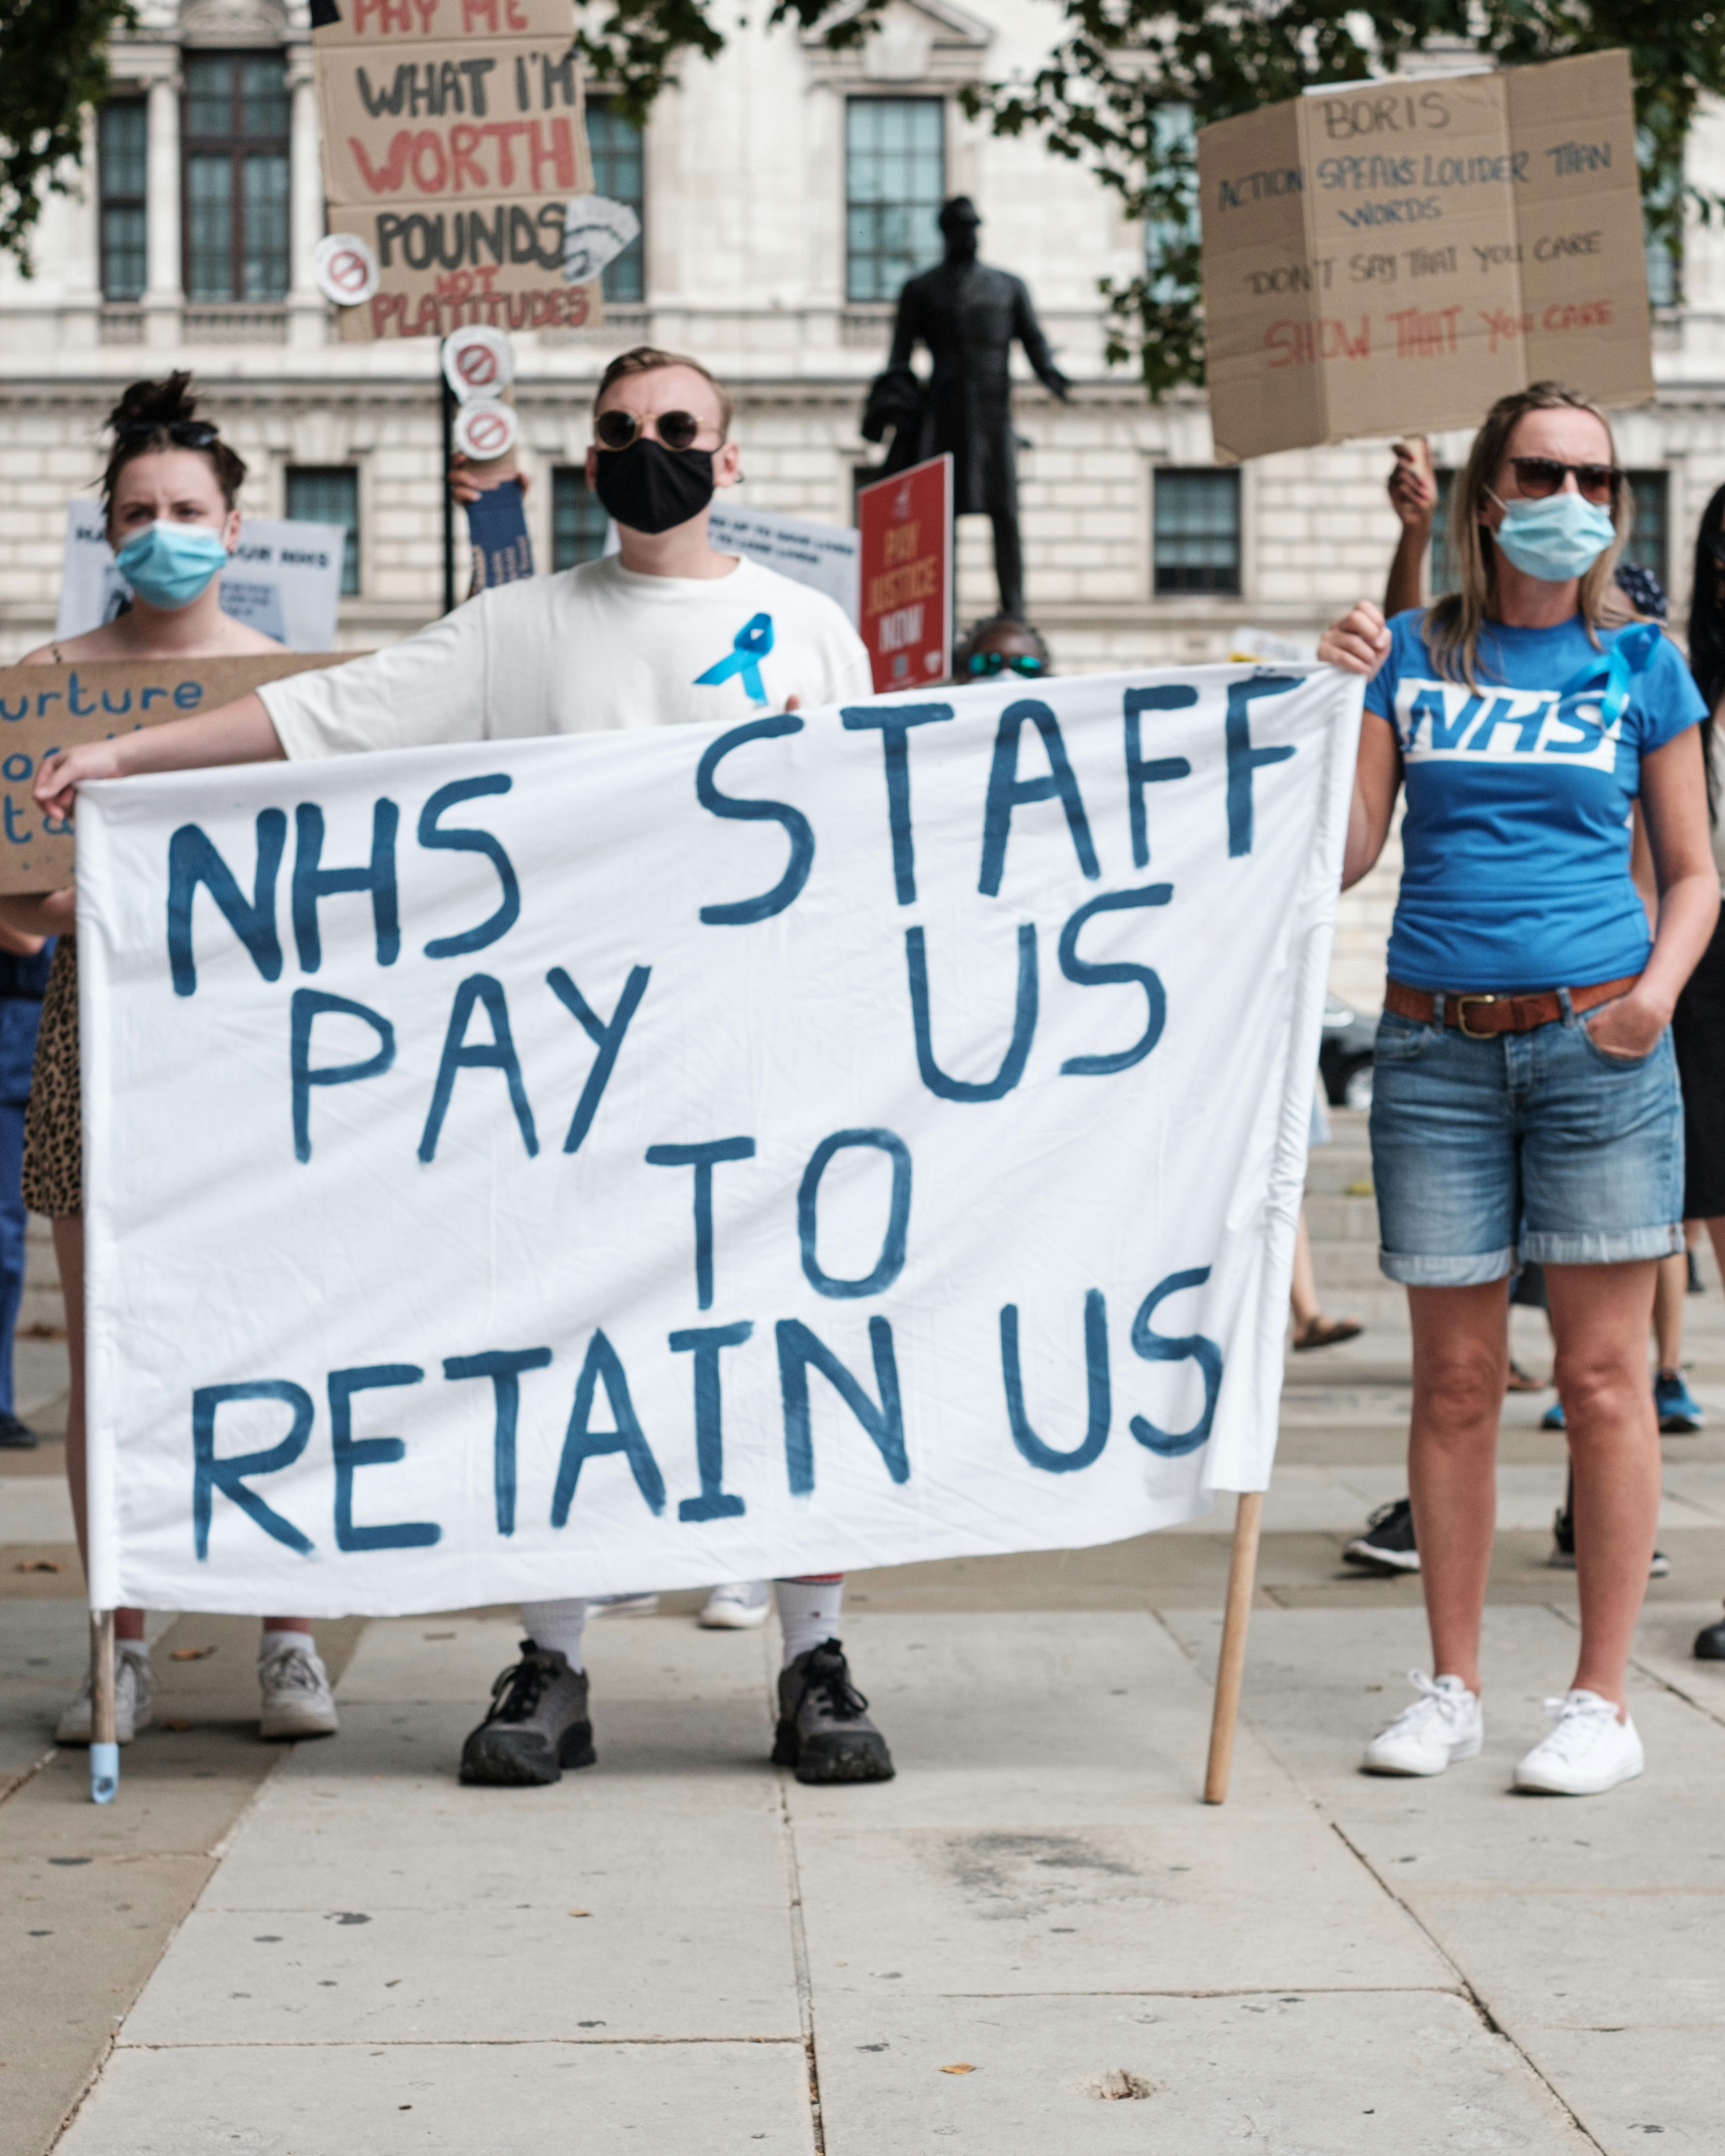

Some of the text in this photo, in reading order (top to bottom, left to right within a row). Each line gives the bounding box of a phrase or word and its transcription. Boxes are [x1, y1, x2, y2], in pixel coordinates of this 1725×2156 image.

[352, 0, 529, 35] PAY ME
[355, 51, 577, 118] WHAT I'M
[1321, 92, 1451, 140] BORIS
[348, 117, 576, 194] WORTH
[1218, 141, 1611, 212] ACTION SPEAKS LOUDER THAN
[375, 202, 567, 270] POUNDS
[1337, 195, 1443, 227] WORDS
[436, 266, 500, 297] NOT
[1243, 256, 1336, 295] DON'T
[1349, 251, 1397, 285] SAY
[1401, 245, 1458, 278] THAT
[1534, 229, 1603, 262] CARE
[371, 287, 590, 337] PLATITUDES
[1263, 312, 1370, 368] SHOW
[1386, 303, 1463, 359] THAT
[1542, 298, 1611, 331] CARE
[880, 605, 922, 653] NOW
[1406, 687, 1605, 754] NHS
[167, 673, 1307, 998] NHS STAFF
[291, 882, 1173, 1164] PAY US
[644, 1127, 913, 1311] TO
[191, 1265, 1224, 1562] RETAIN US
